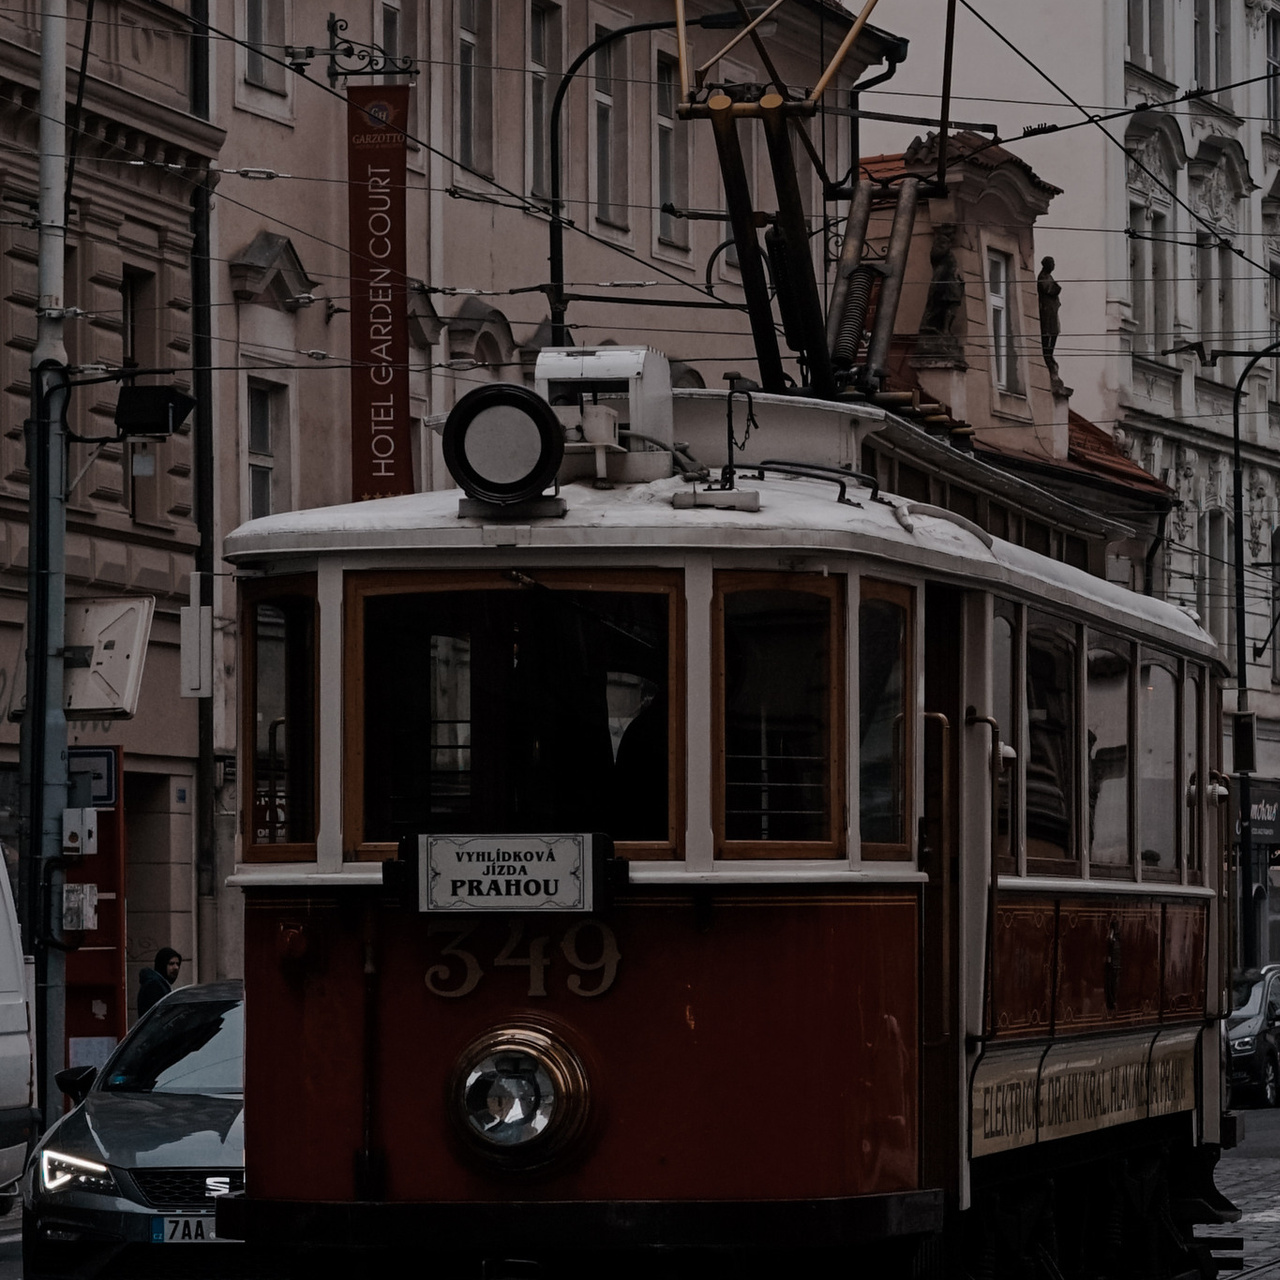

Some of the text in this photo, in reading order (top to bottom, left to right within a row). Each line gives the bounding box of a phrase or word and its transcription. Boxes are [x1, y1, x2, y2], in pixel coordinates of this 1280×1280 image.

[352, 133, 405, 144] GARZOTTO
[368, 165, 391, 259] COURT
[369, 269, 394, 386] GARDEN
[371, 394, 395, 476] HOTEL
[455, 848, 557, 862] VYHLÍDKOVÁ
[482, 862, 528, 876] JÍZDA
[451, 879, 560, 897] PRAHOU
[424, 919, 623, 998] 349
[168, 1220, 205, 1240] 7AA
